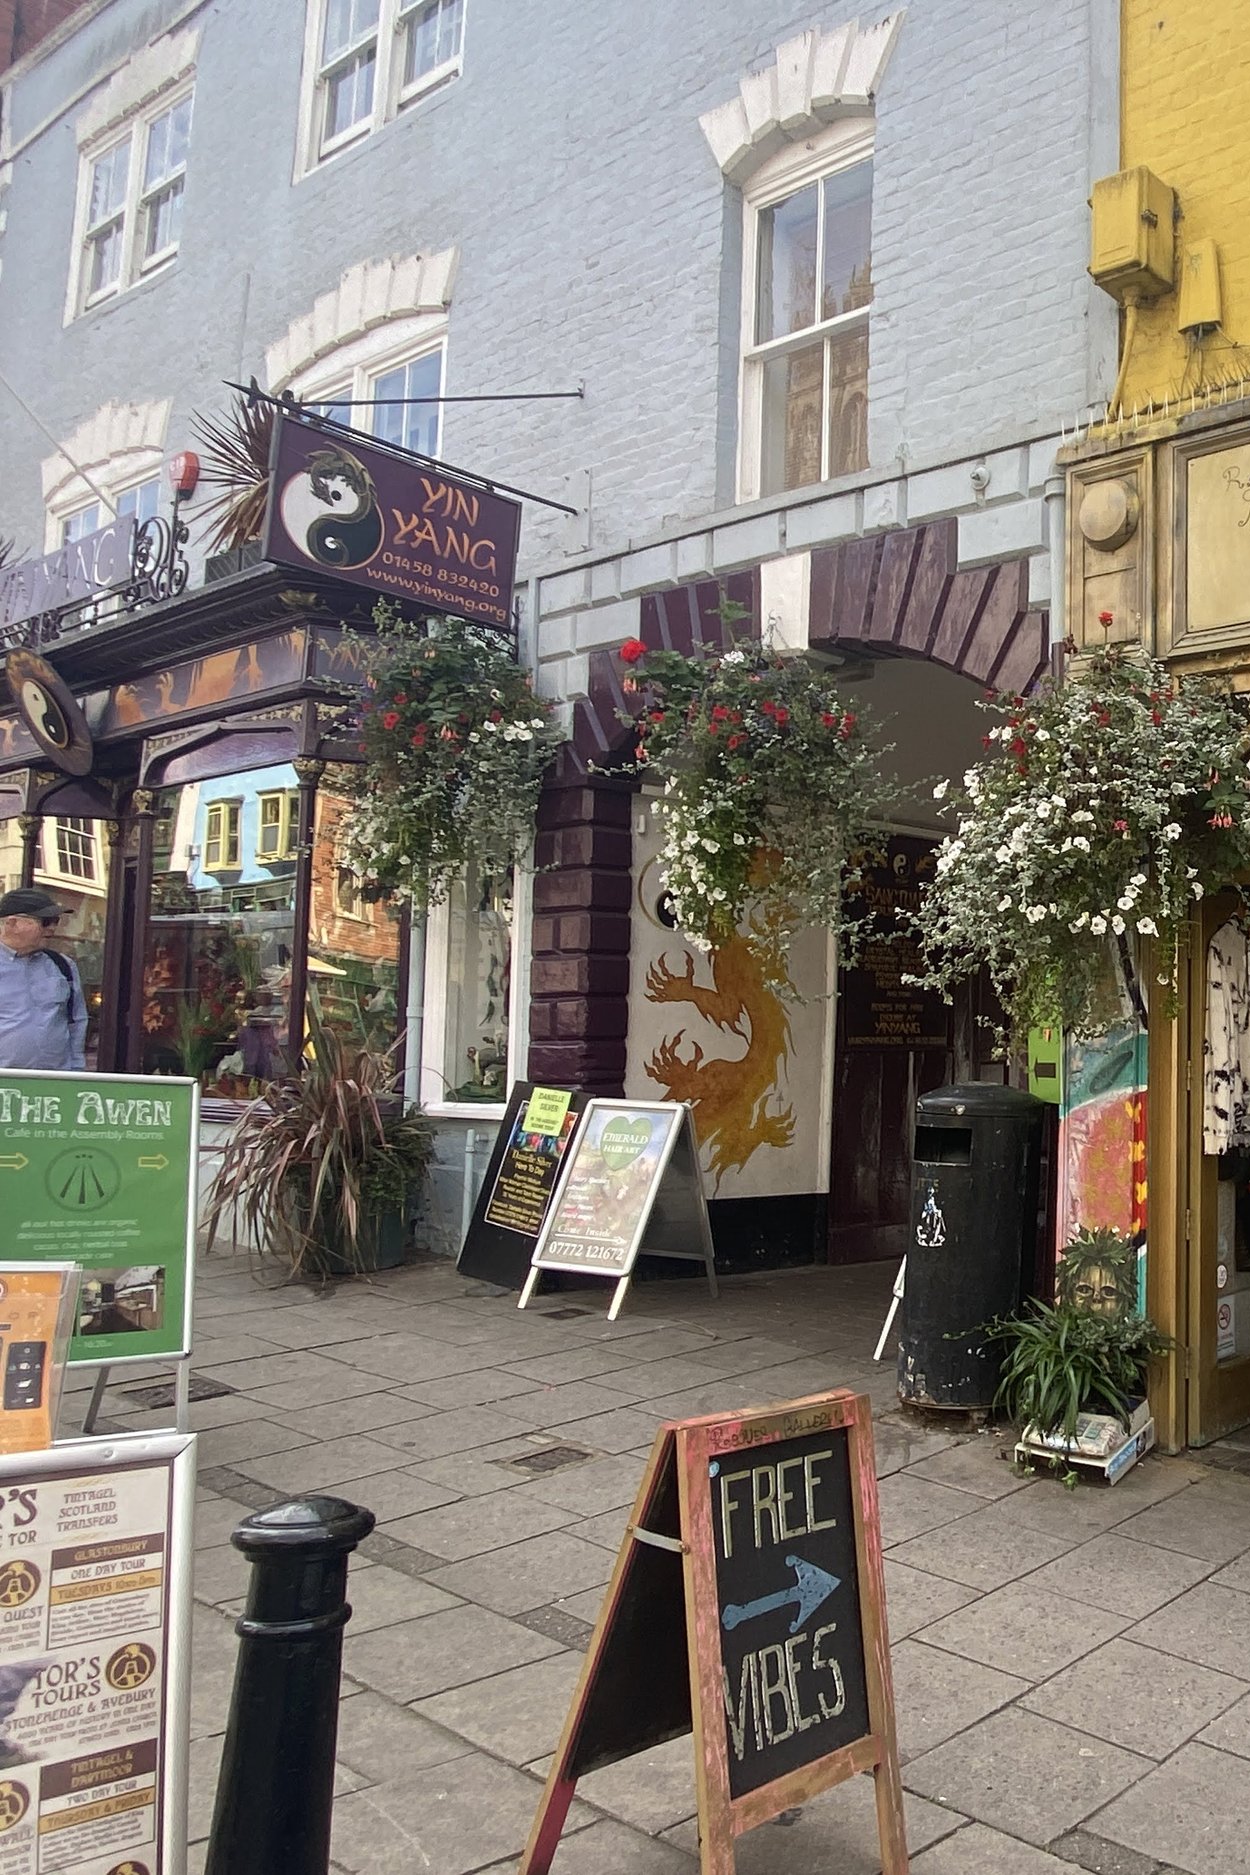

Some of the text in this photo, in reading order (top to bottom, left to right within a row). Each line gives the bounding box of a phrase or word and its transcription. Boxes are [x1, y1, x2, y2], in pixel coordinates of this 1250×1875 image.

[420, 477, 480, 527] YIN
[391, 508, 497, 577] YANG
[382, 551, 500, 598] 01458 832420
[366, 567, 507, 622] www.yinyang.org
[0, 1088, 172, 1126] THE AWEN
[34, 1129, 46, 1138] in
[49, 1129, 67, 1139] the
[71, 1130, 122, 1141] Assembly
[603, 1131, 648, 1144] EMERALD
[549, 1241, 625, 1260] 07772 121672
[58, 1501, 117, 1518] SCOTLAND
[63, 1488, 117, 1504] TINTAGEL
[719, 1449, 837, 1559] FREE
[8, 1514, 118, 1547] TOR TRANSFERS
[71, 1558, 146, 1580] ONE DAY TOUR
[4, 1606, 44, 1622] QUEST
[37, 1655, 100, 1690] TOR'S
[31, 1680, 101, 1708] TOURS
[722, 1623, 845, 1761] VIBES
[5, 1688, 157, 1733] STONEHENGE & AVEBURY
